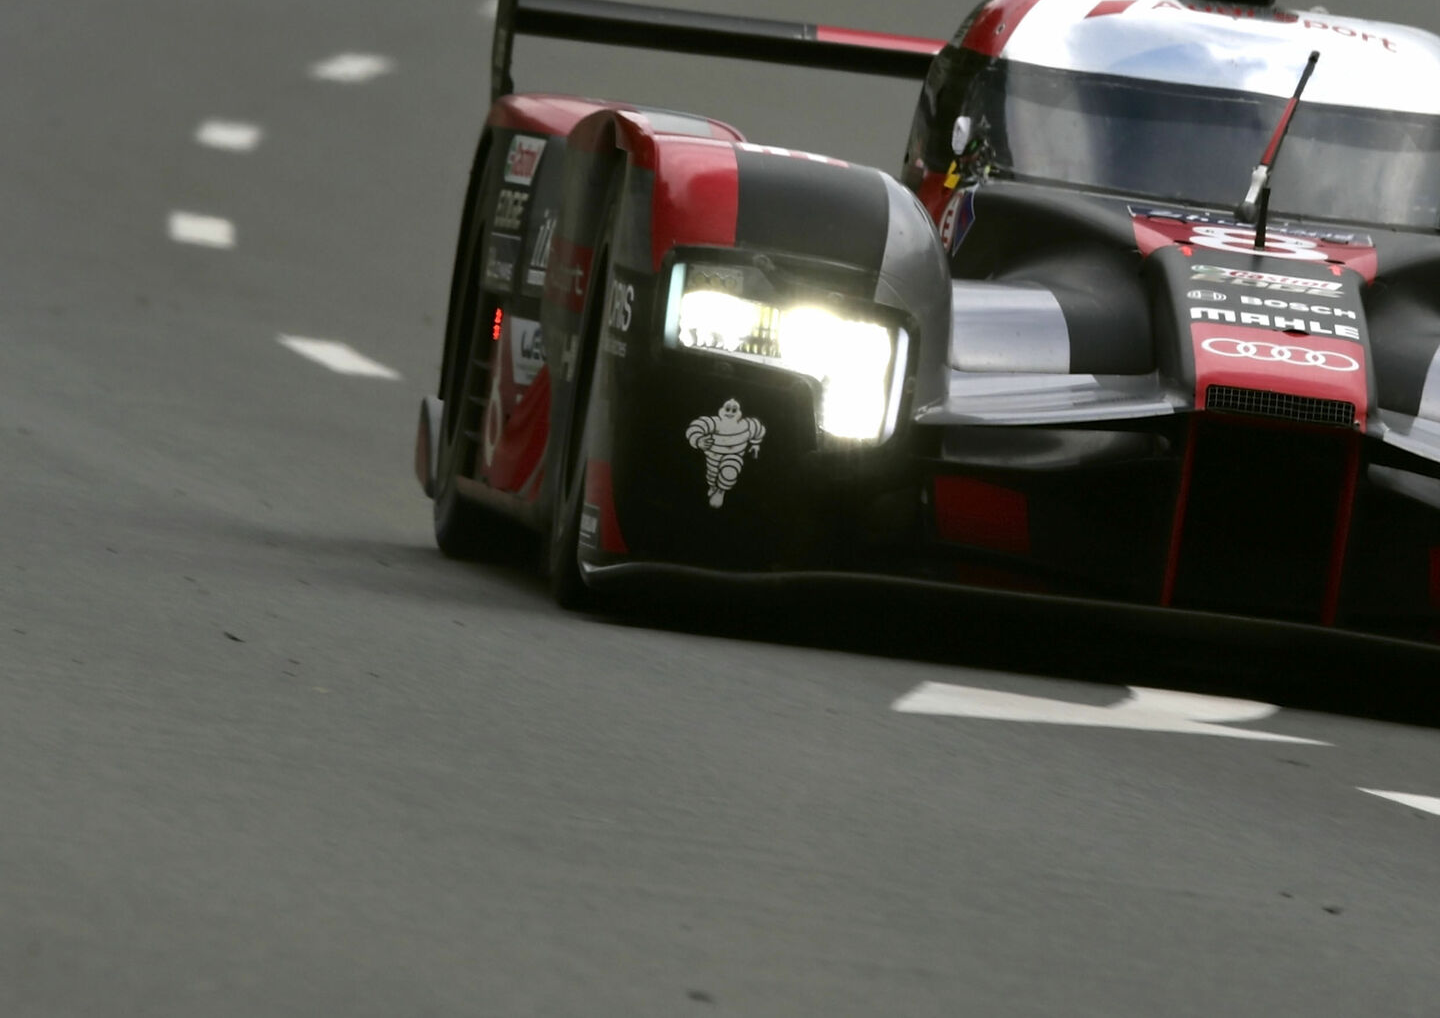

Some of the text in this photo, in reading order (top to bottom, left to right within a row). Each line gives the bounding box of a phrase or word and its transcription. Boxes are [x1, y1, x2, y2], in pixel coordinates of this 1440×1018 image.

[1188, 225, 1329, 261] 8
[1228, 268, 1332, 291] Castrol
[1240, 294, 1357, 320] BOSCH
[1189, 306, 1361, 341] MAHLE
